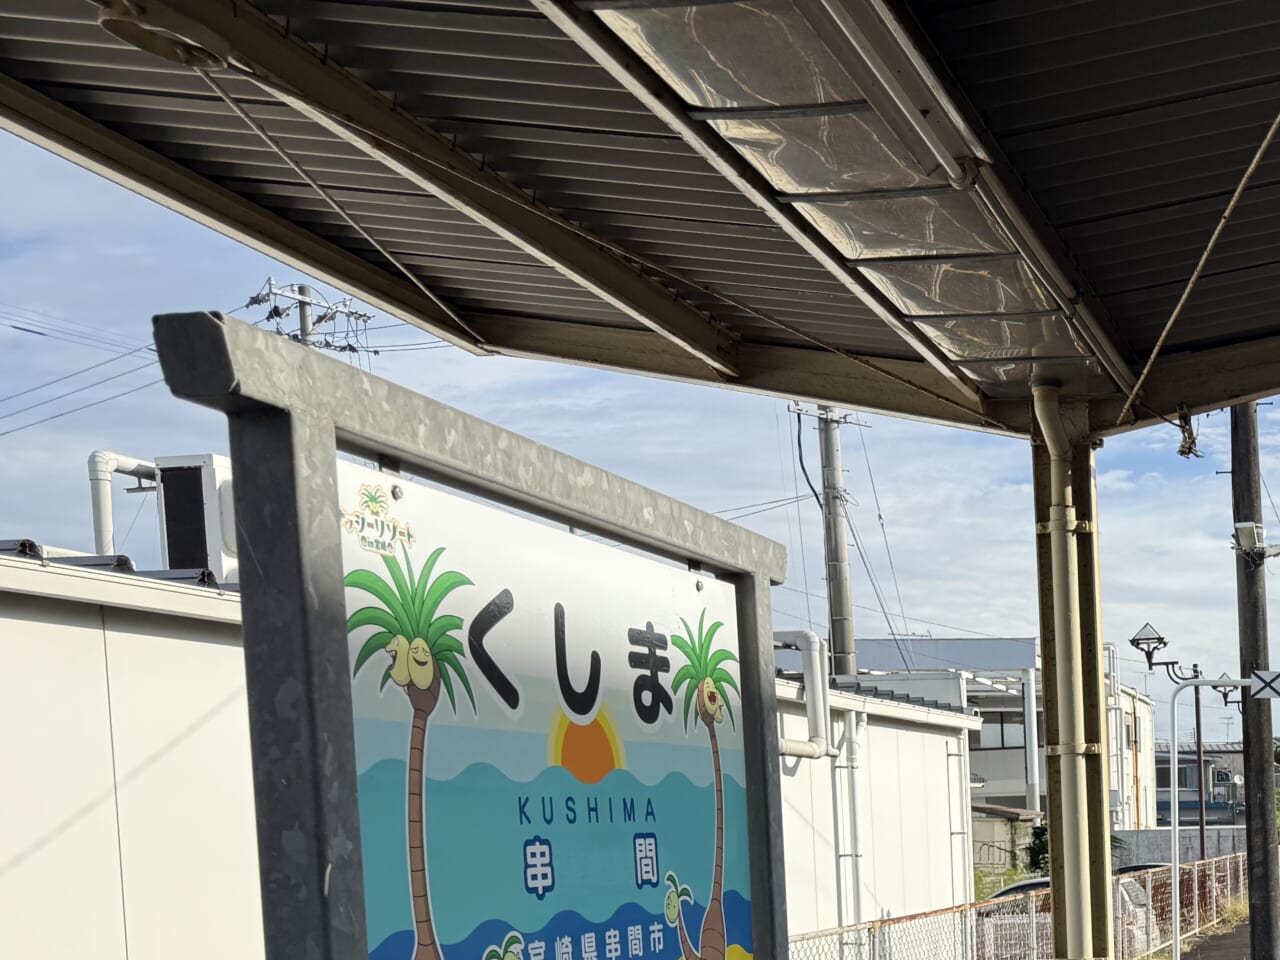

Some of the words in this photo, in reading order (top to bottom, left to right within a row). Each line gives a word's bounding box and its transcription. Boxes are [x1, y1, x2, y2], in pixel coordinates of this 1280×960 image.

[468, 588, 673, 724] くしま
[518, 796, 656, 825] KUSHIMA
[524, 833, 660, 900] 串間
